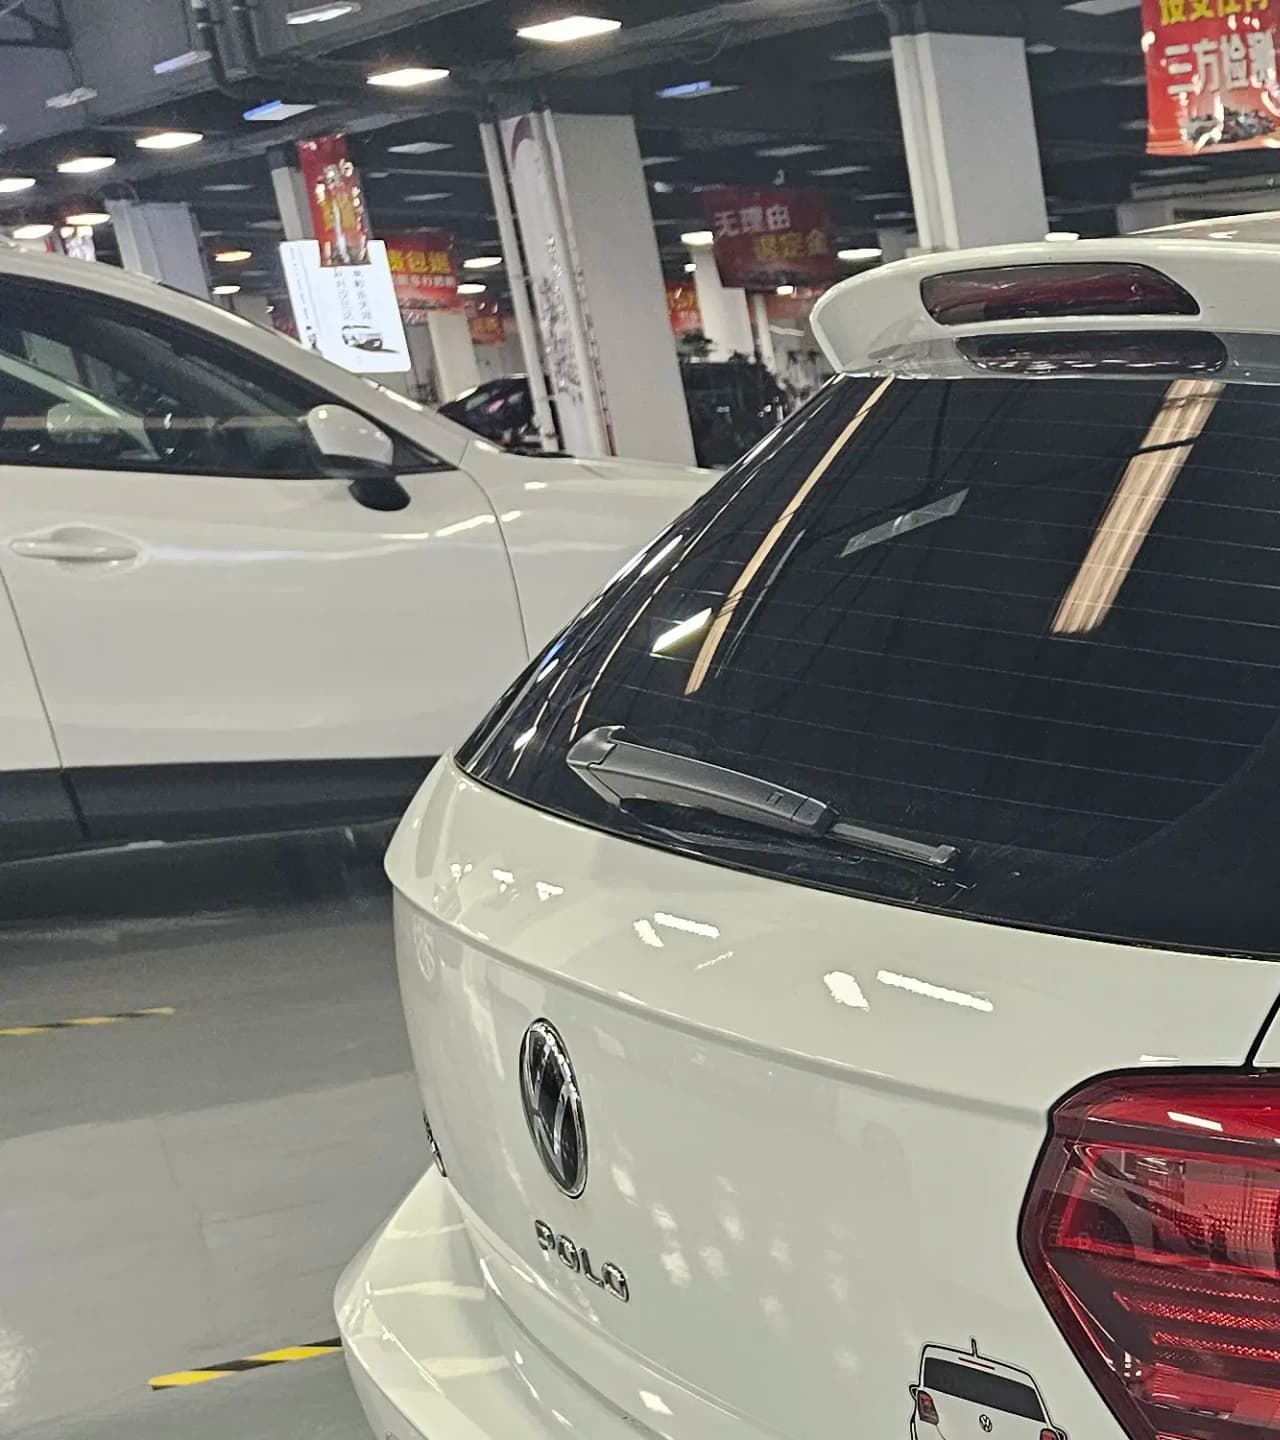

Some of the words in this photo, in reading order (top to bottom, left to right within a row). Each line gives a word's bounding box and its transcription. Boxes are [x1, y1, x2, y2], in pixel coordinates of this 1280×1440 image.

[1164, 31, 1279, 95] 三方检测
[535, 1219, 629, 1302] POLO
